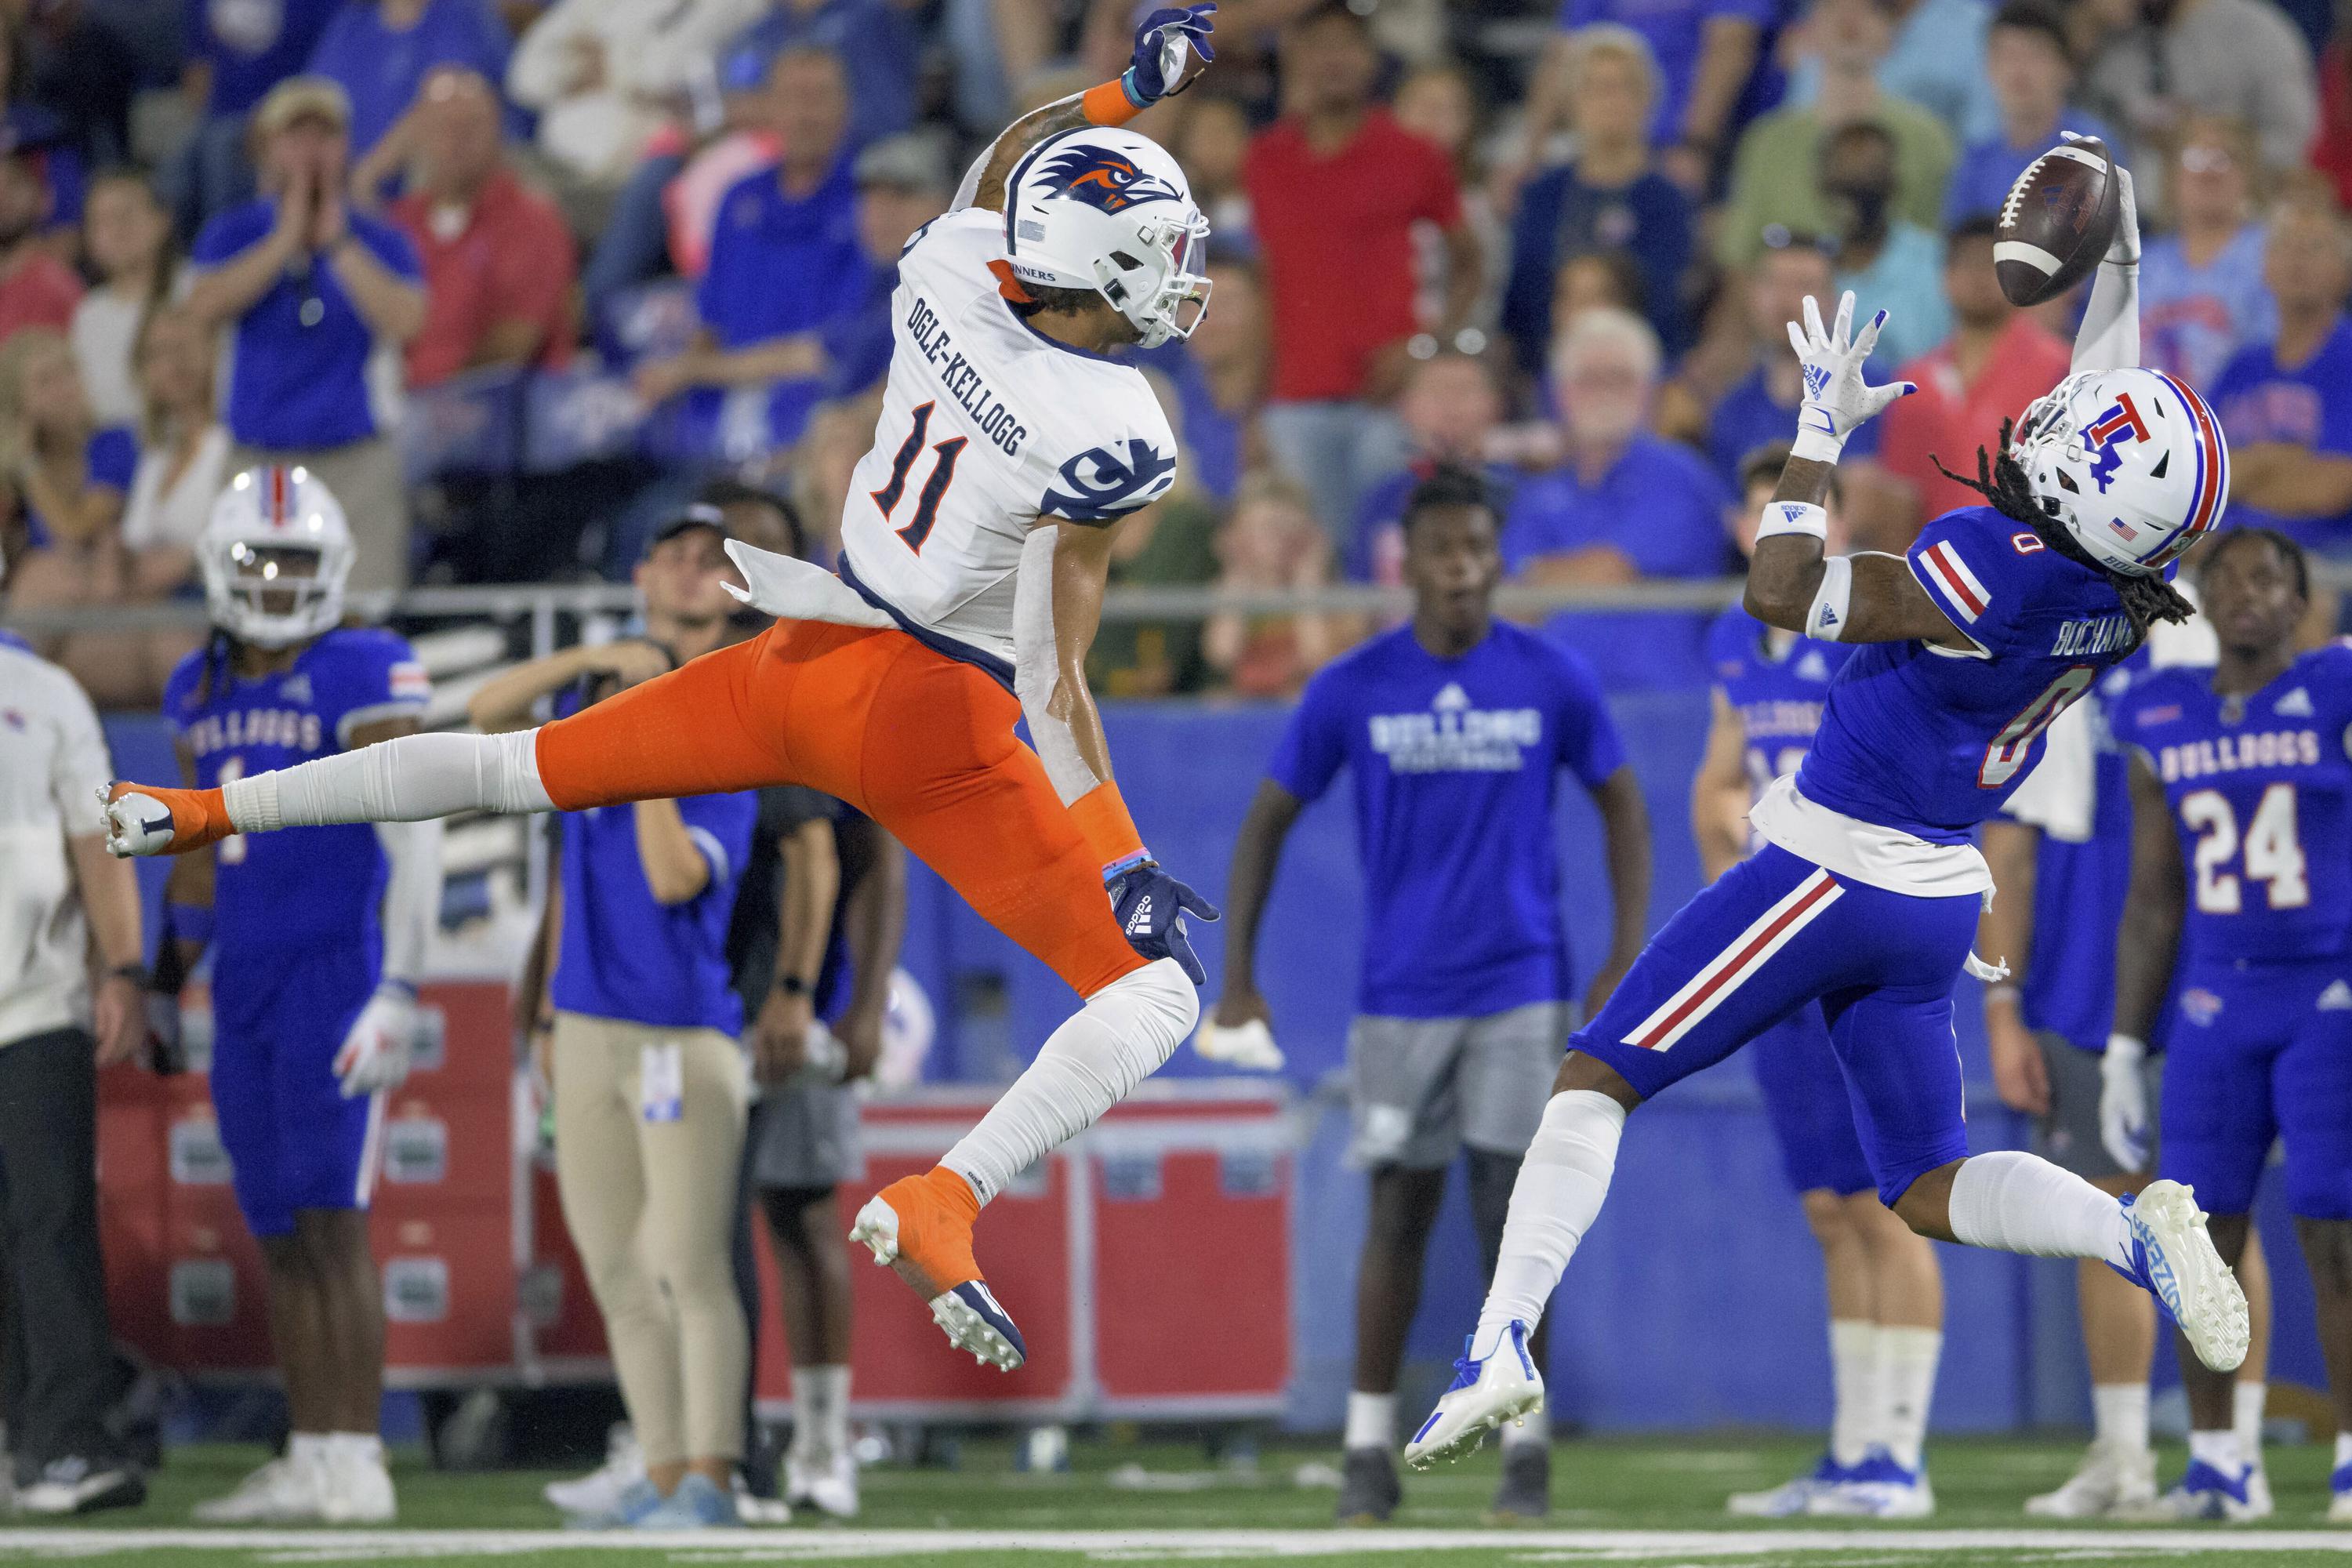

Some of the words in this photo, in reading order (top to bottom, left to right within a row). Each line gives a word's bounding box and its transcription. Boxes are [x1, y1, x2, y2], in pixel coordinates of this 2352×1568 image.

[907, 297, 1027, 456] OGLE-KELLOGG
[869, 400, 969, 558] 11
[2010, 532, 2045, 557] 0
[1976, 664, 2097, 789] 0
[2159, 729, 2321, 784] BULLDOGS
[2180, 782, 2310, 914] 24
[1125, 895, 1152, 936] adidas
